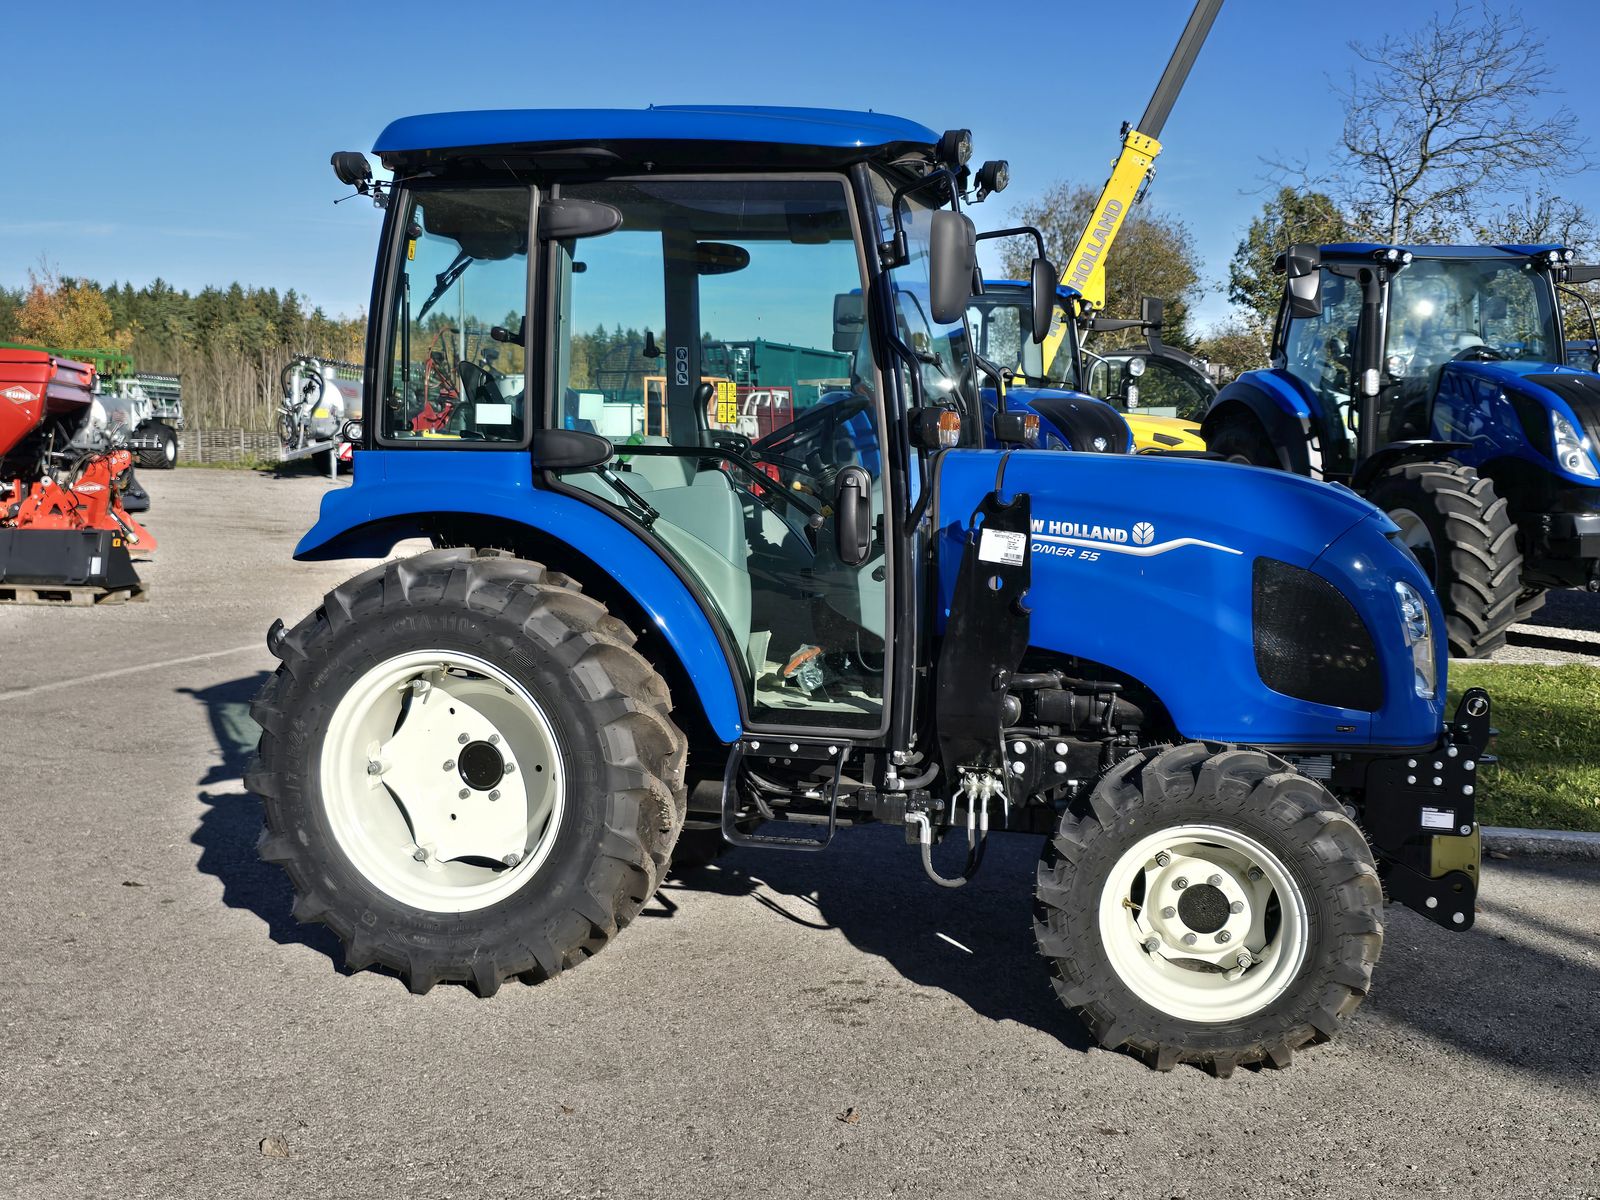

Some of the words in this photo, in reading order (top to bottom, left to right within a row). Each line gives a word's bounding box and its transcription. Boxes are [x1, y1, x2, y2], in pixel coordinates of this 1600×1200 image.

[1068, 199, 1123, 290] HOLLAND
[1048, 520, 1128, 543] HOLLAND
[1031, 543, 1076, 557] OMER
[1078, 550, 1101, 562] 55
